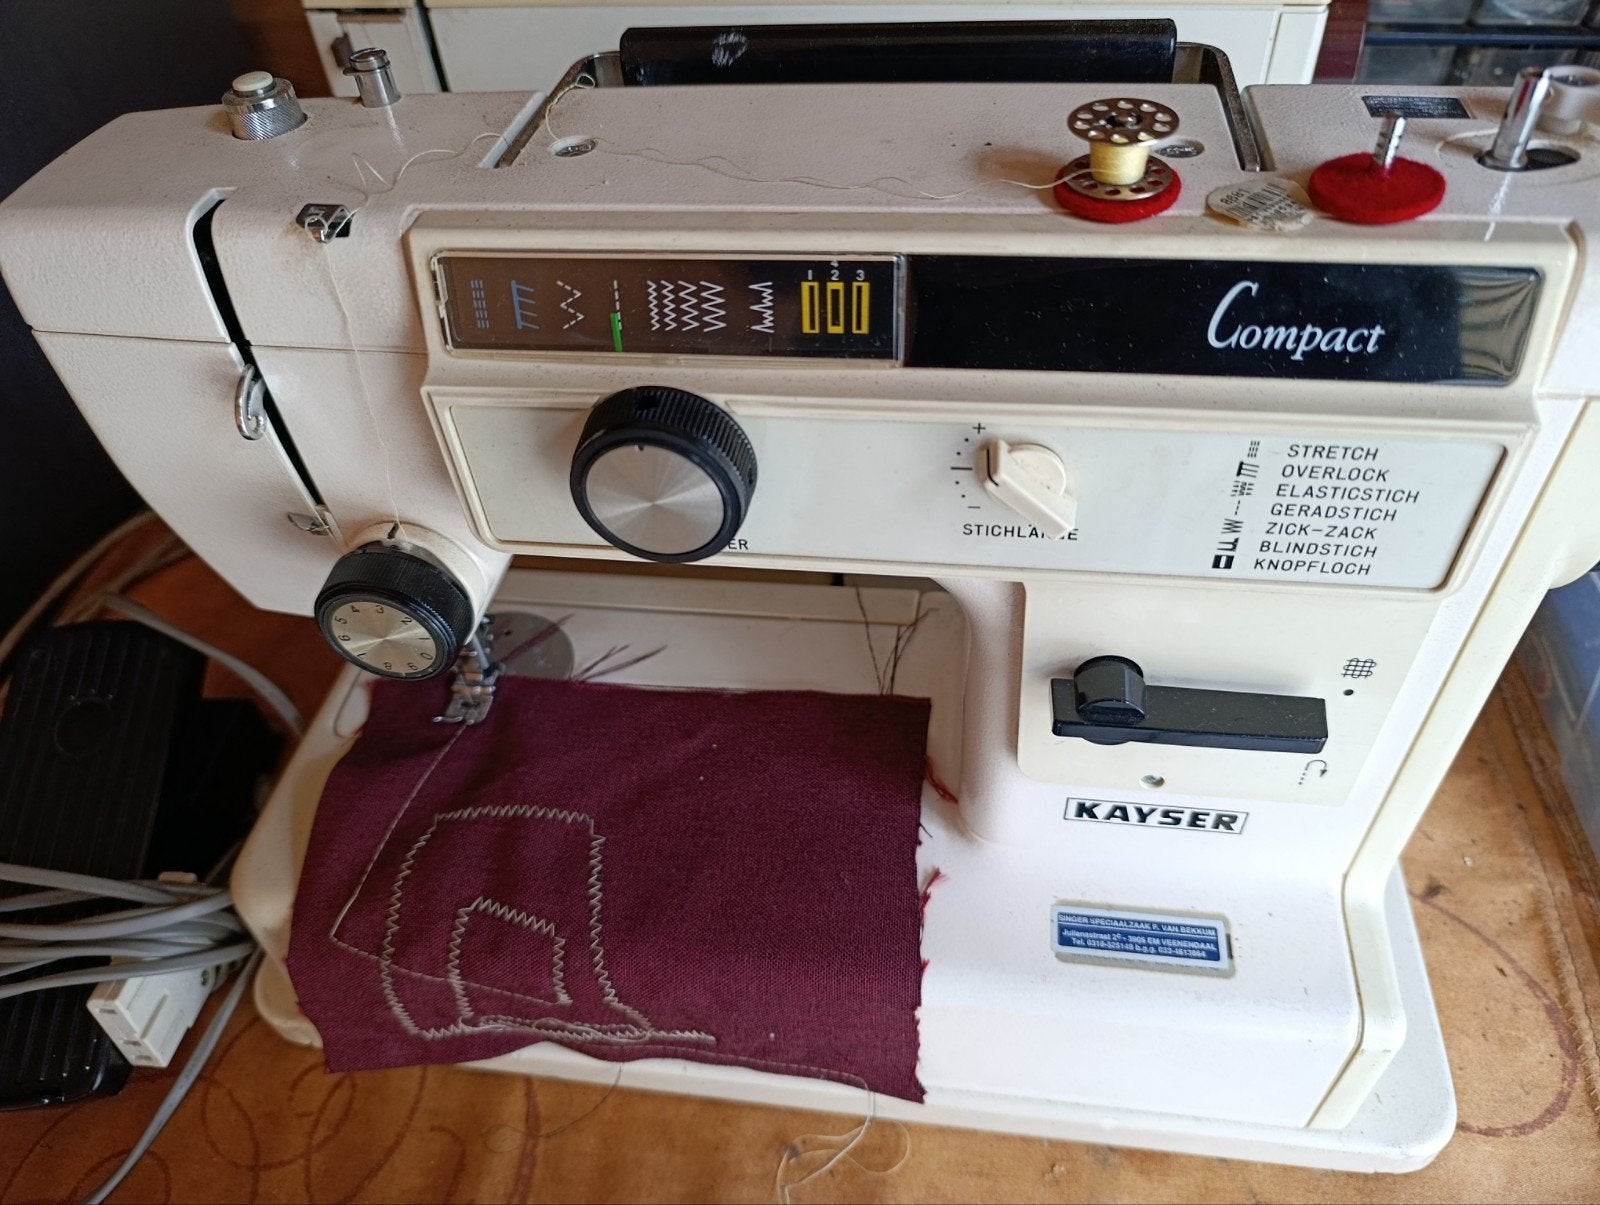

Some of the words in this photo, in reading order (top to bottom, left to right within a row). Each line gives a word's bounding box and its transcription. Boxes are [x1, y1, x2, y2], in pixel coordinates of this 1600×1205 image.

[807, 269, 813, 280] 1
[830, 269, 840, 281] 2
[856, 269, 865, 281] 3
[1207, 280, 1386, 361] Compact
[1287, 444, 1379, 461] STRETCH
[1281, 464, 1390, 482] OVERLOCK
[1276, 484, 1420, 503] ELASTICSTICH
[1270, 503, 1398, 522] GERADSTICH
[962, 523, 1079, 541] STICHLÄE
[1265, 522, 1378, 540] ZICK-ZACK
[1259, 541, 1378, 558] BLINDSTICH
[1254, 558, 1371, 576] KNOPFLOCH
[350, 604, 361, 613] 4
[376, 604, 384, 614] 3
[335, 616, 348, 625] 5
[401, 616, 412, 626] 2
[1073, 801, 1239, 831] KAYSER
[1058, 914, 1089, 924] SINGER
[1089, 918, 1151, 930] SPECIAALZAAK
[1161, 924, 1179, 933] VAN
[1071, 937, 1086, 946] Tel.
